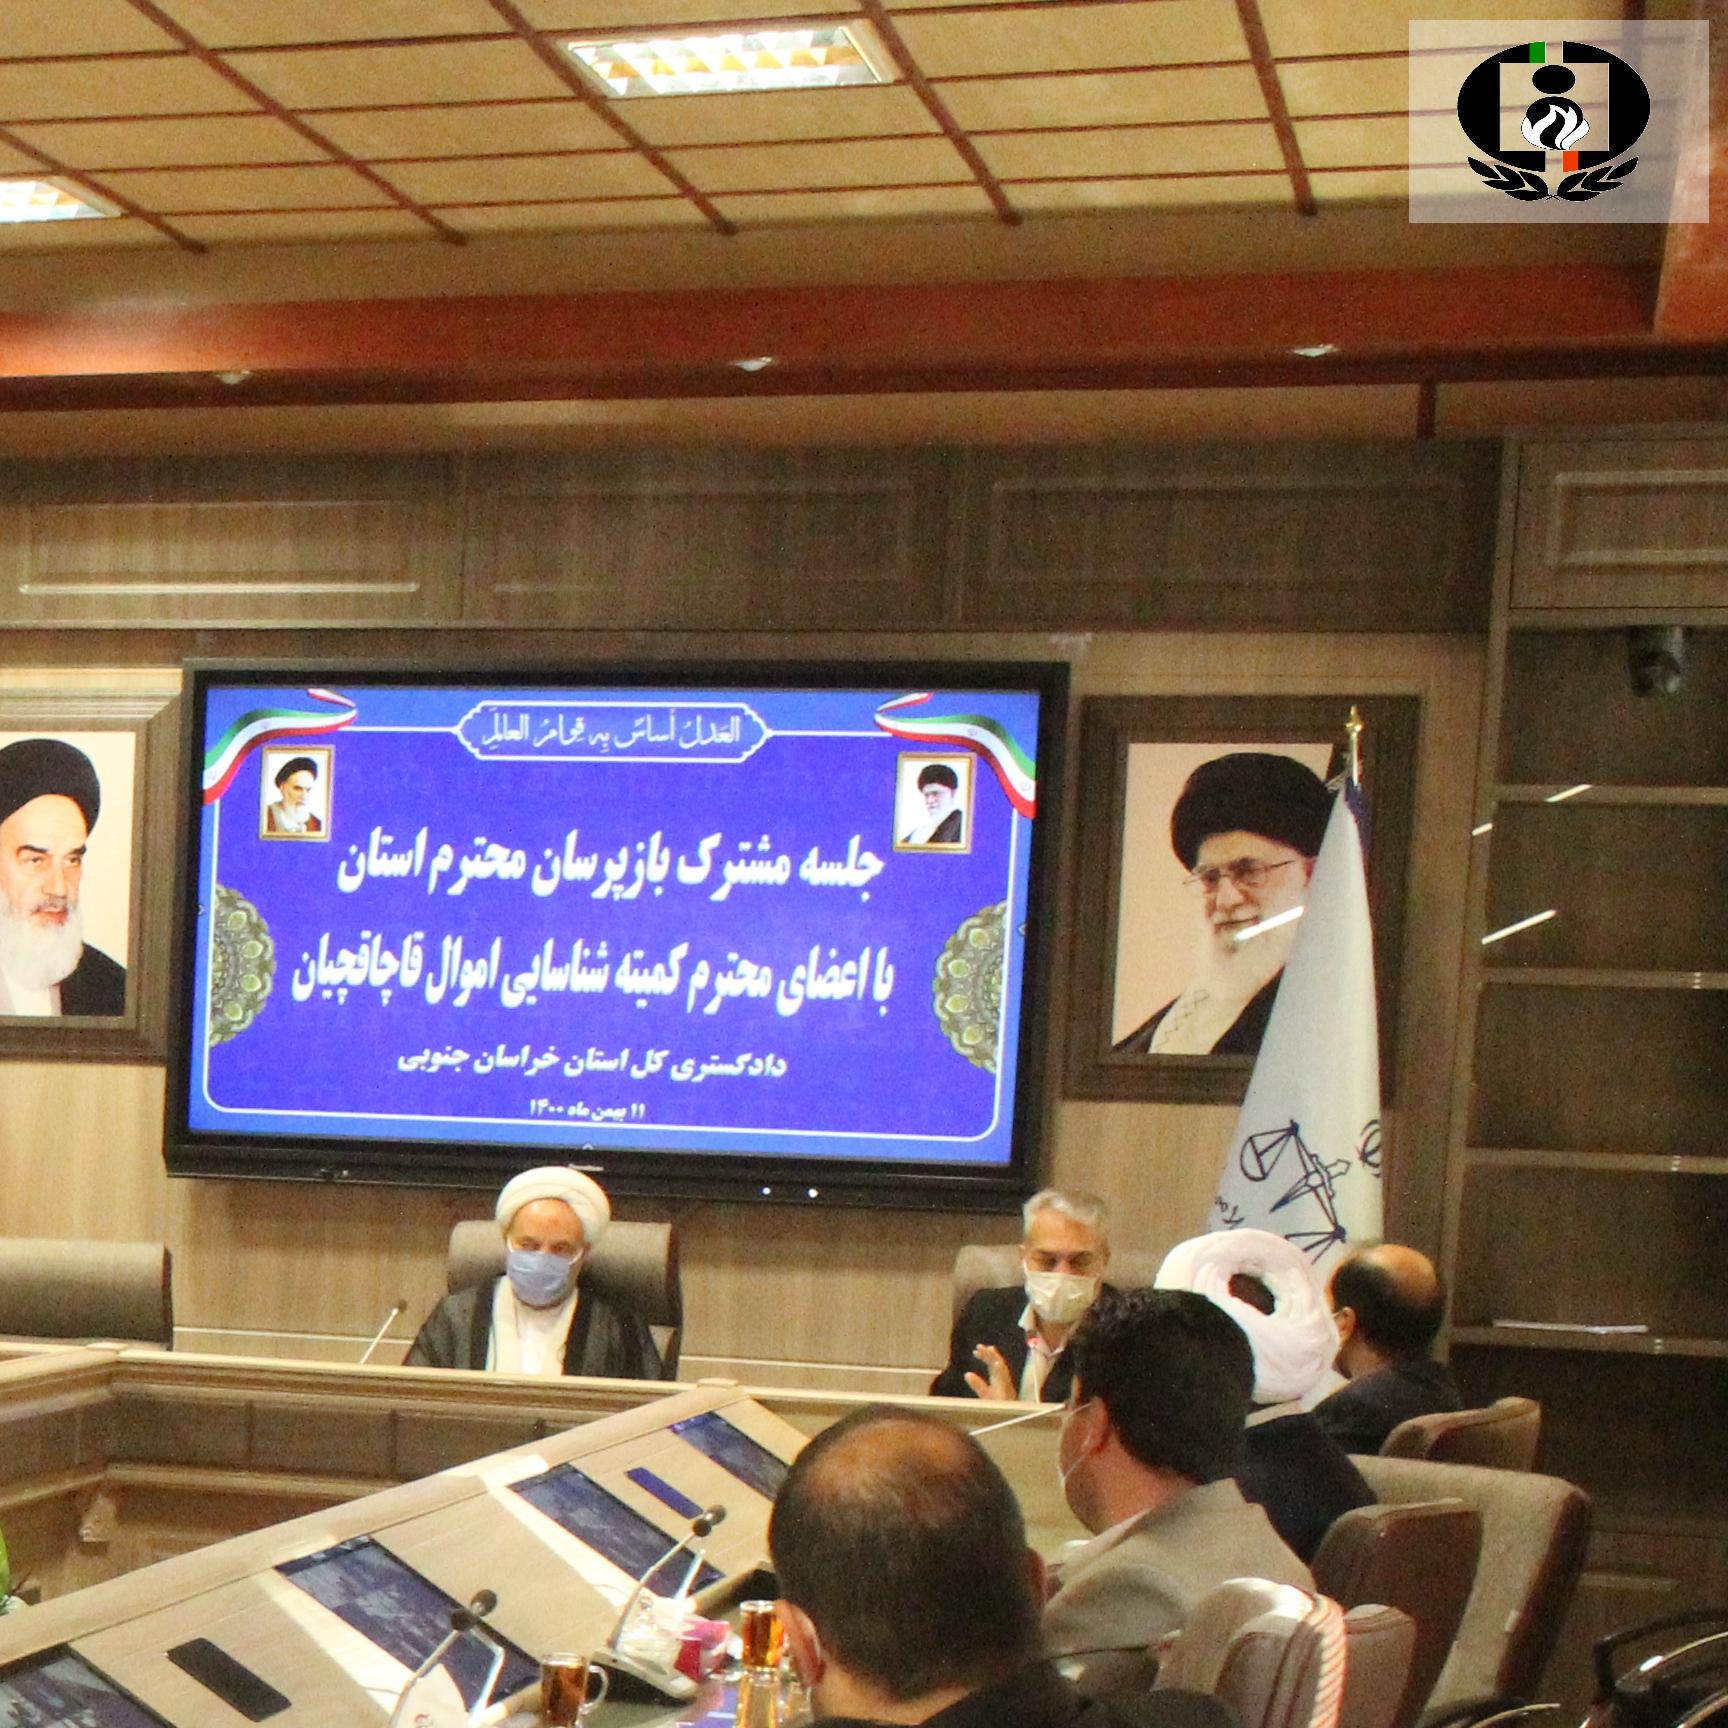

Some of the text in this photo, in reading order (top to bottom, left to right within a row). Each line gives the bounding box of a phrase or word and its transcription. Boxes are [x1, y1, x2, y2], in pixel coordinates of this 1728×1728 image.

[336, 825, 885, 902] جلسه مشترک بازپرسان محترم استان
[290, 929, 895, 1018] با اعضای محترم کمیته شناسایی اموال قاچاقچیان
[396, 1043, 788, 1083] دادگستری کل استان خراسان جنوبی
[567, 1100, 591, 1117] ماه
[590, 1107, 627, 1122] بهمن
